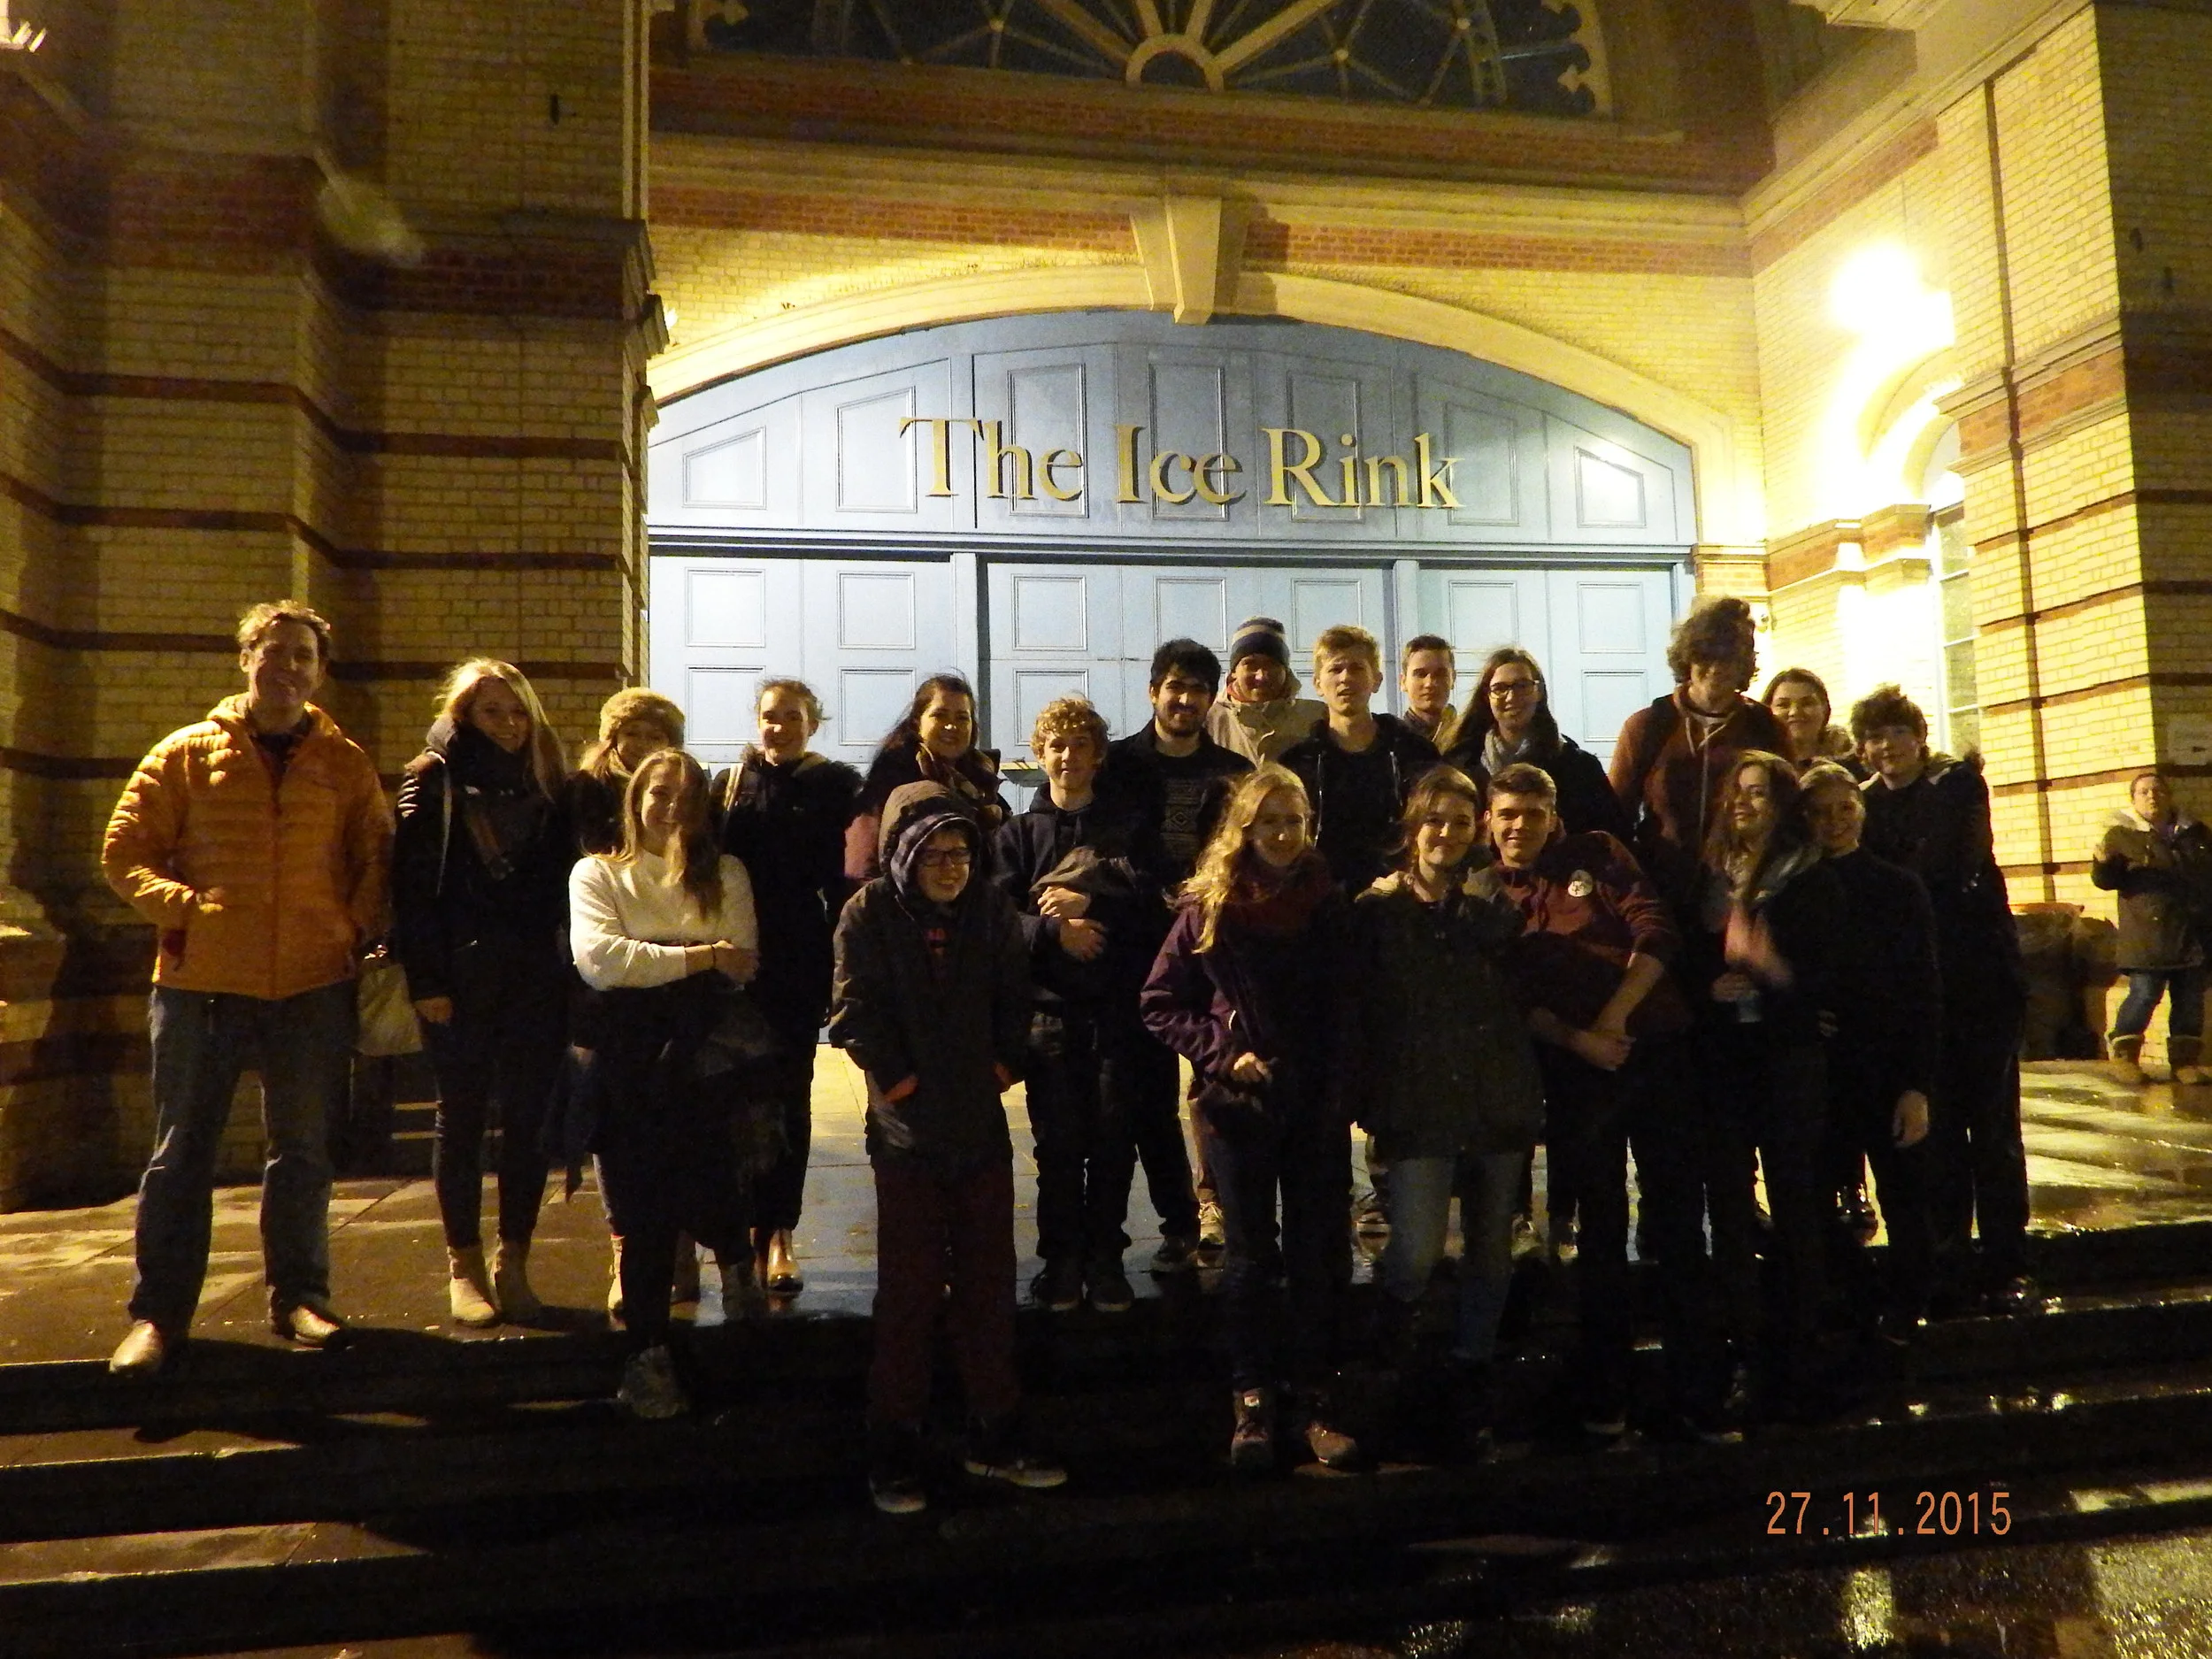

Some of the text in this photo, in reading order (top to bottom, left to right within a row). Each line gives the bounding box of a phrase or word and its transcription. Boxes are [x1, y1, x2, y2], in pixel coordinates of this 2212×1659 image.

[899, 417, 1466, 509] The Ice Rink
